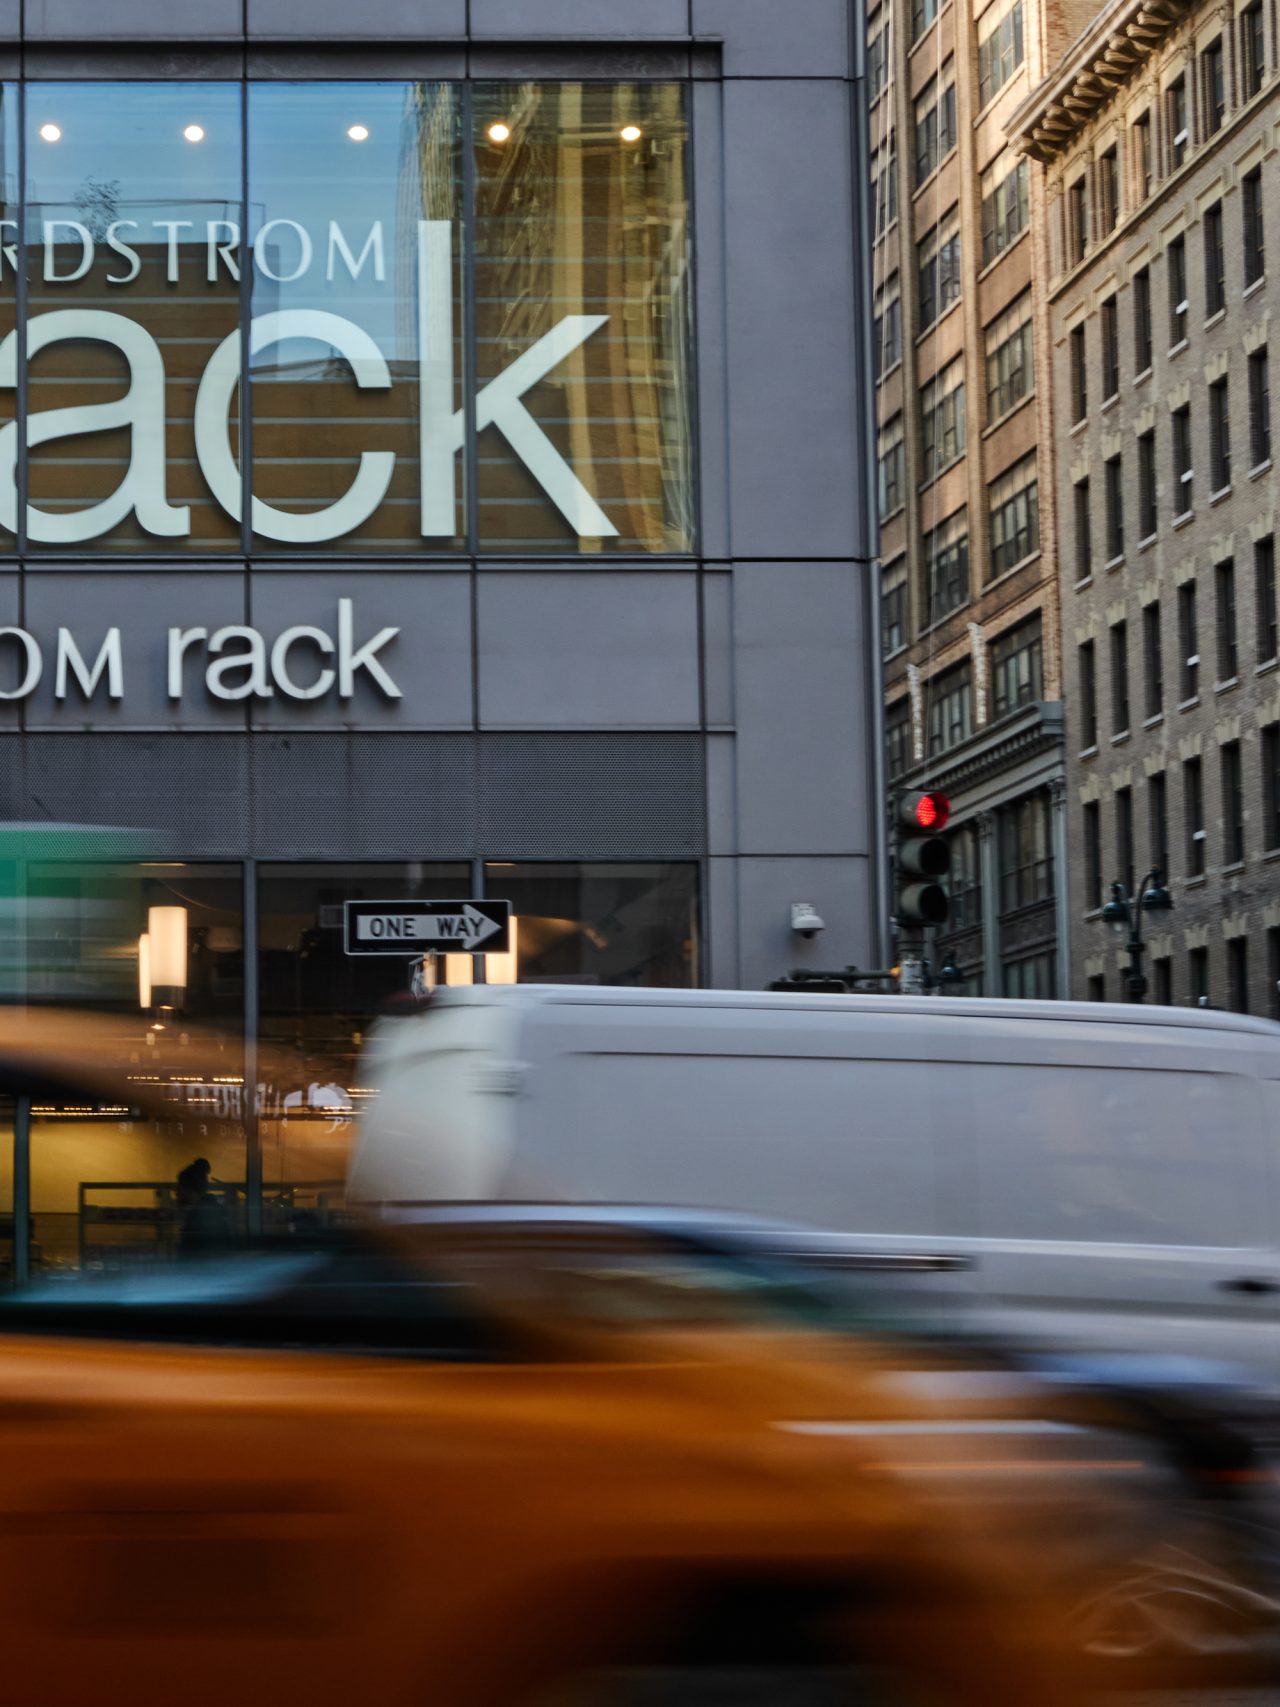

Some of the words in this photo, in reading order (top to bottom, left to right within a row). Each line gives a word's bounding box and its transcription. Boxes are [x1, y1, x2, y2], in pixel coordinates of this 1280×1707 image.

[166, 597, 404, 701] rack
[369, 917, 417, 938] ONE
[436, 917, 486, 938] WAY
